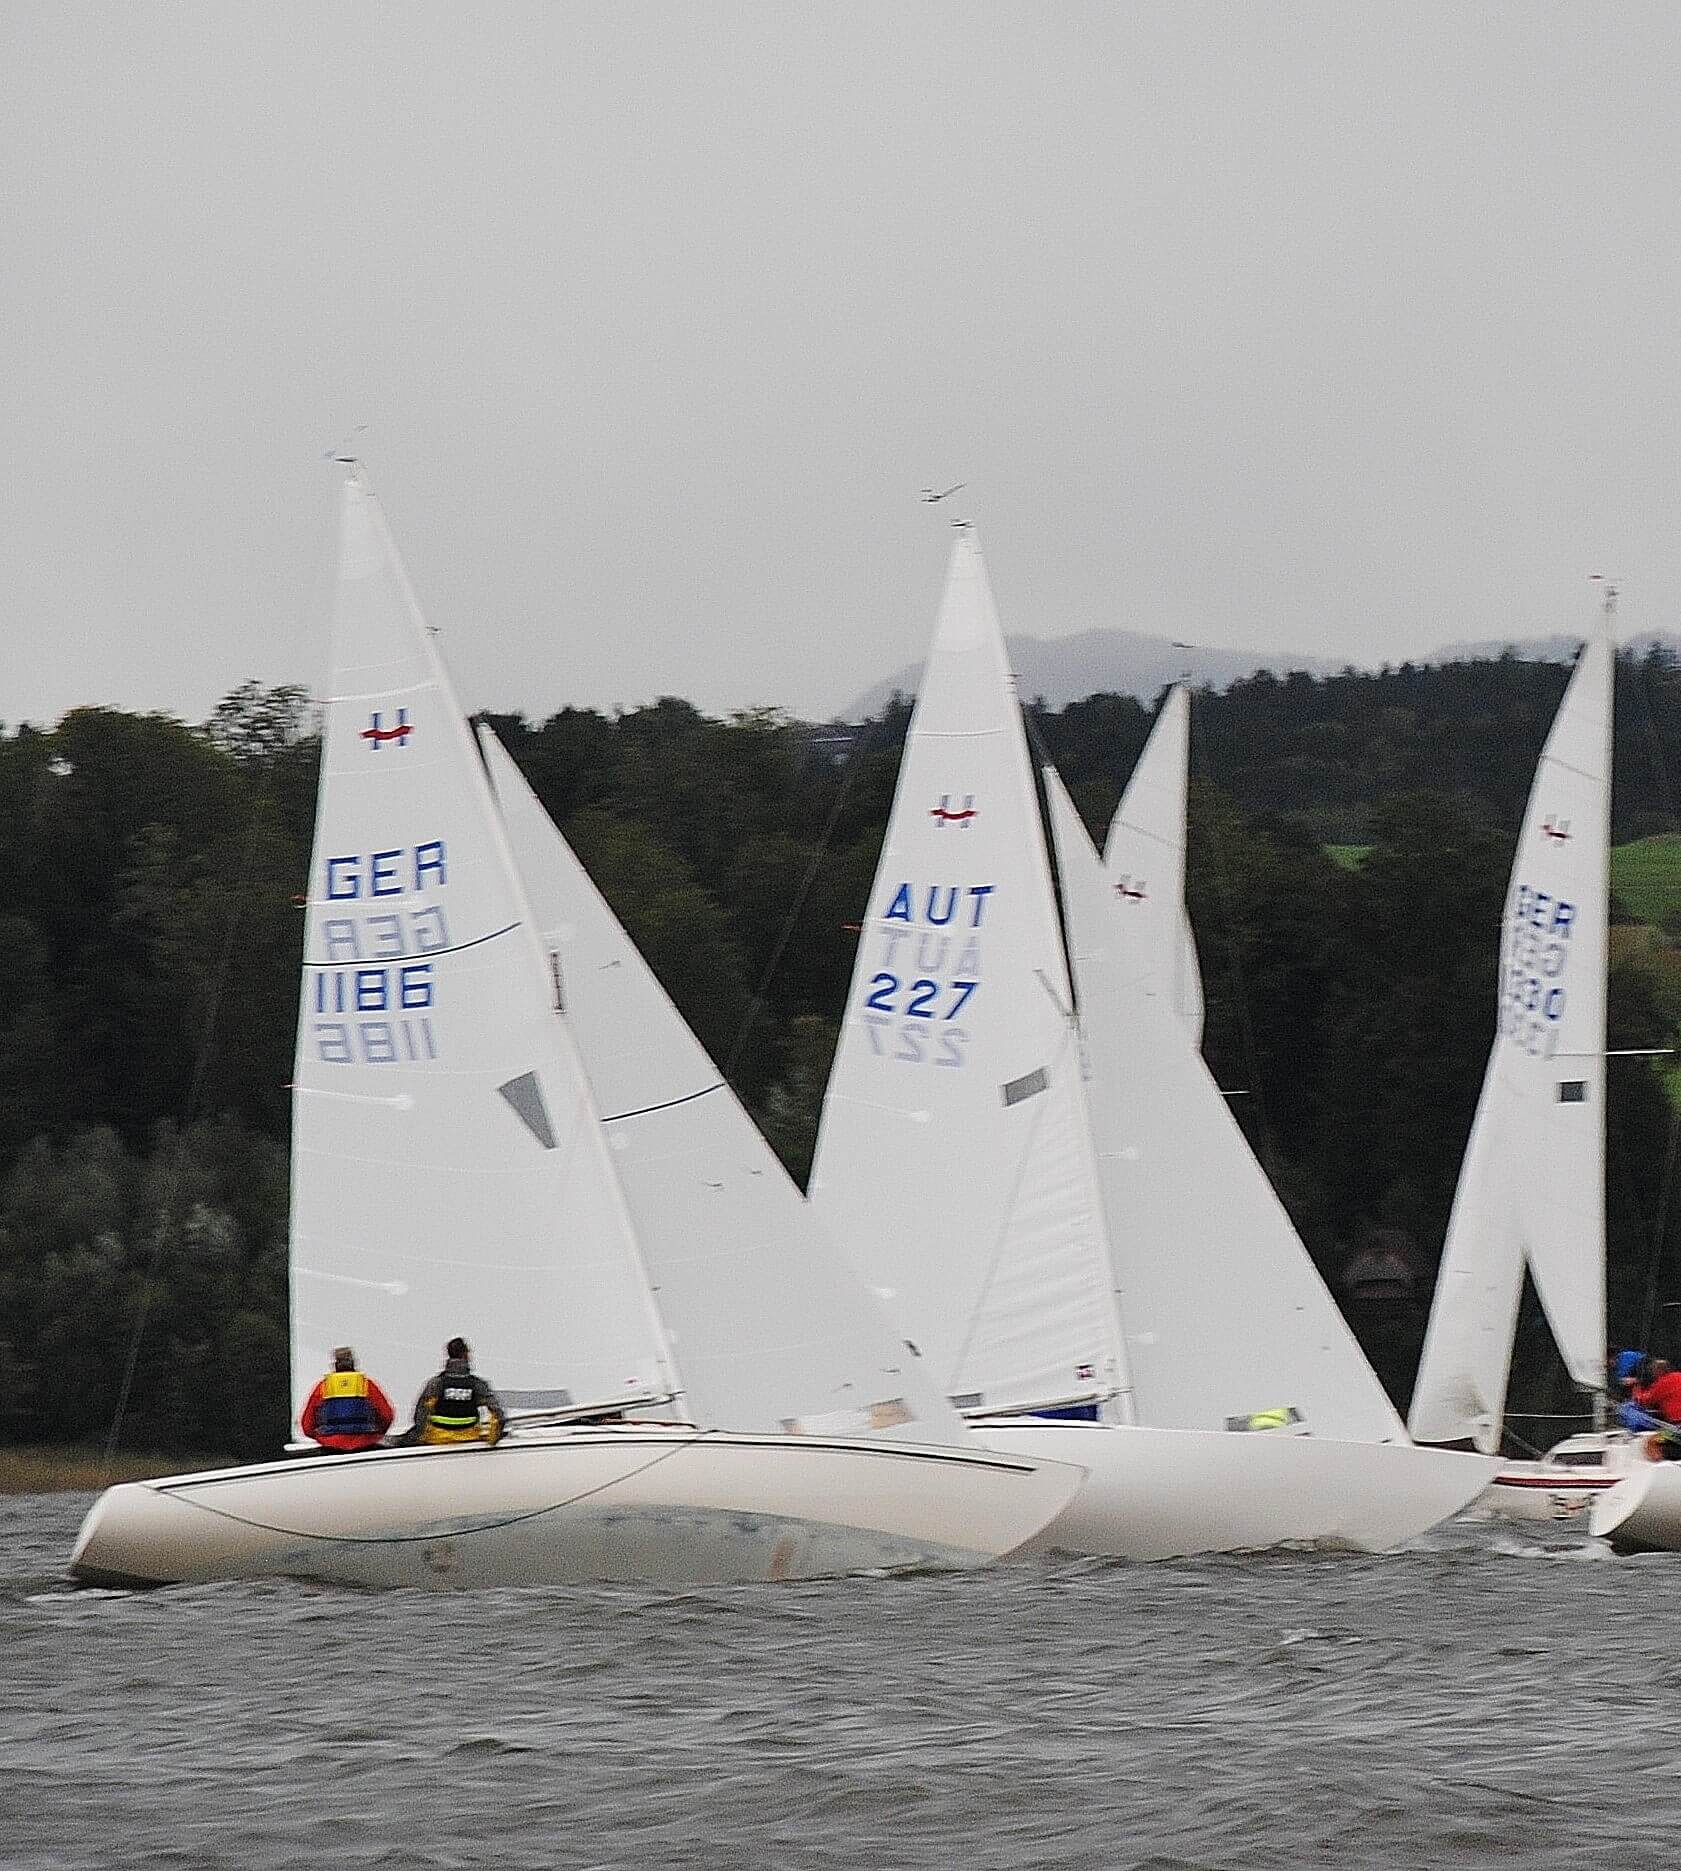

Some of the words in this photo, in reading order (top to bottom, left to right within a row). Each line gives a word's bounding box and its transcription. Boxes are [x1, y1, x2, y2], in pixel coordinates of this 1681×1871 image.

[325, 840, 446, 900] GER
[885, 883, 995, 926] AUT
[317, 965, 434, 1013] 1186
[866, 974, 979, 1020] 227
